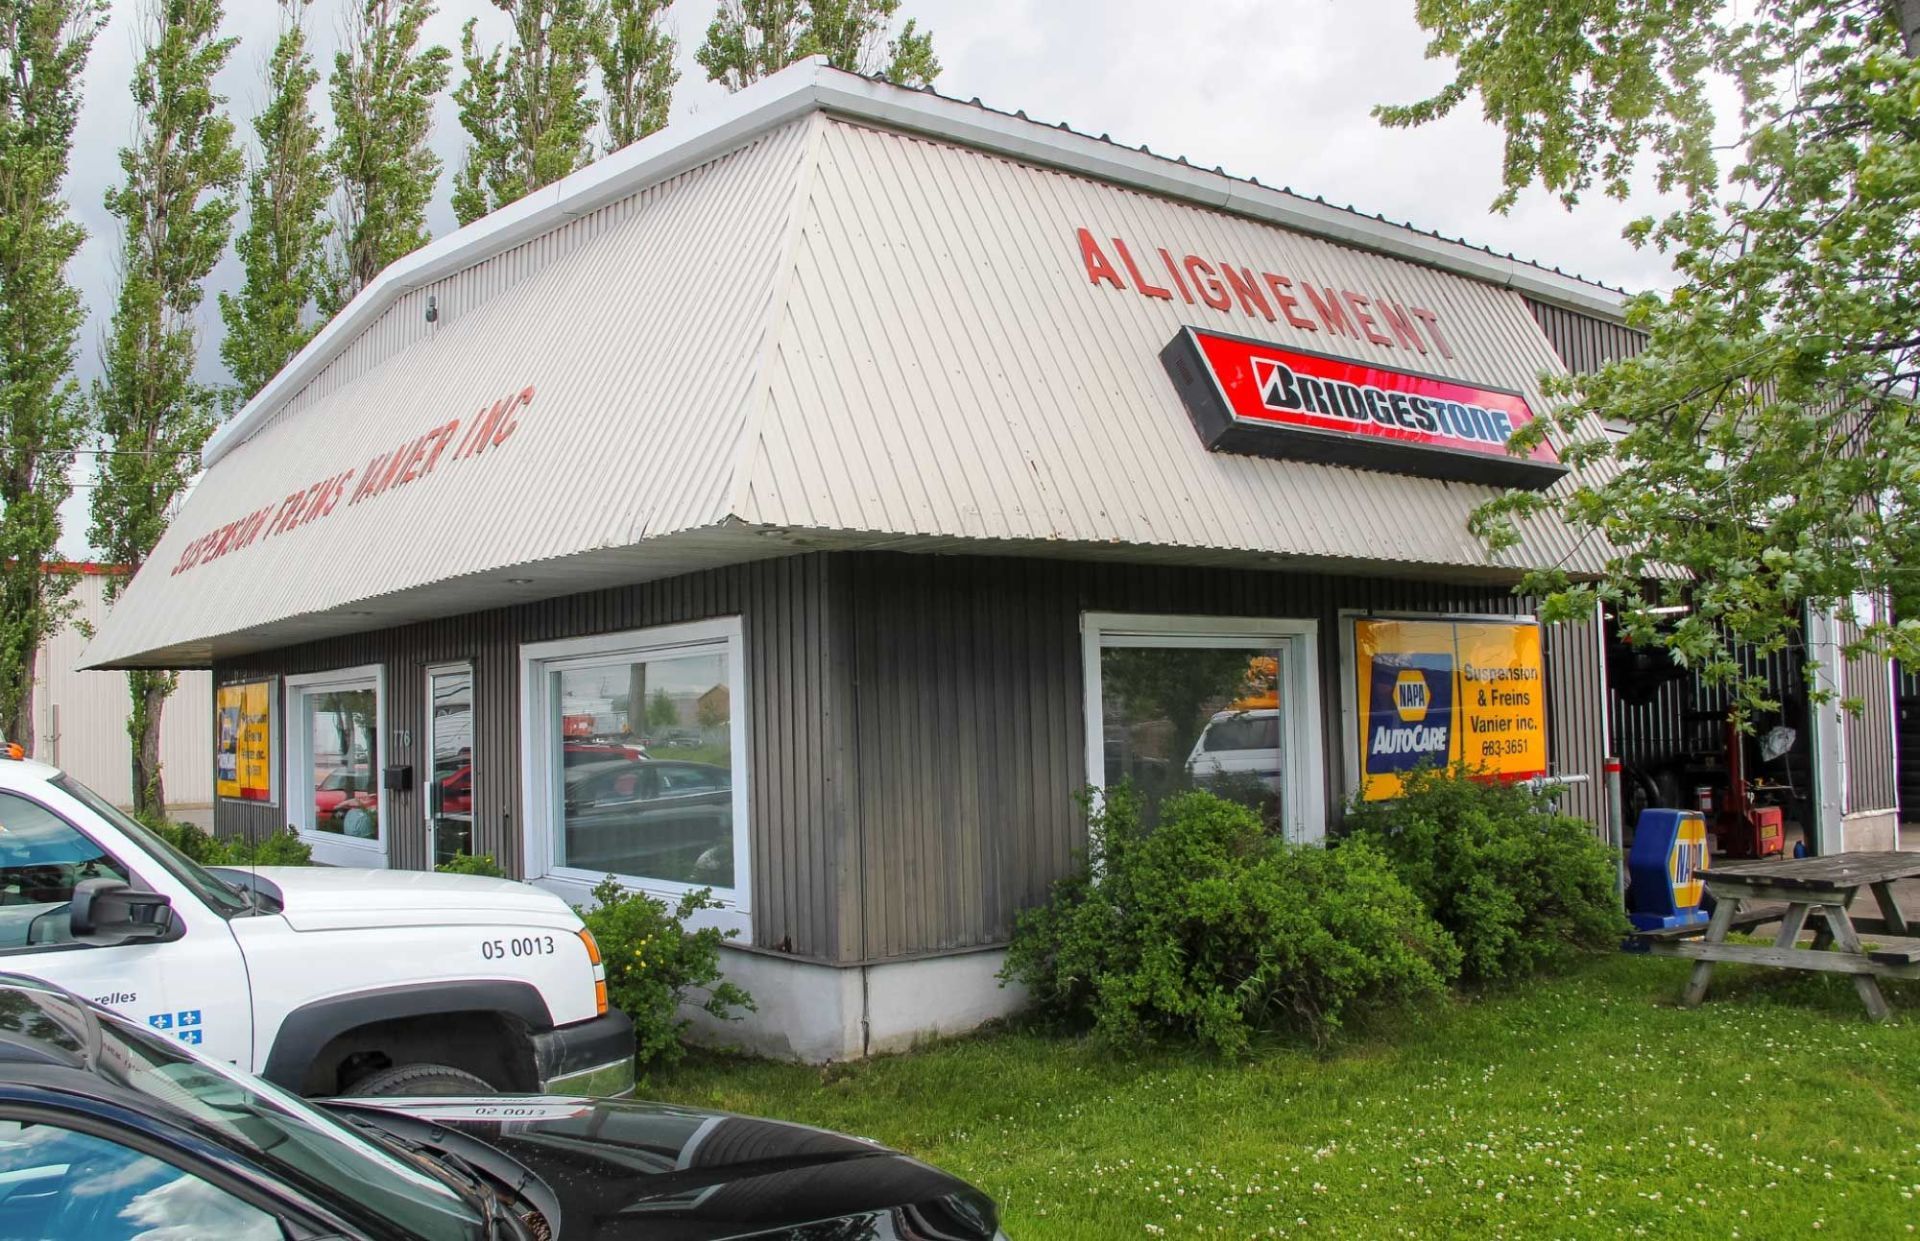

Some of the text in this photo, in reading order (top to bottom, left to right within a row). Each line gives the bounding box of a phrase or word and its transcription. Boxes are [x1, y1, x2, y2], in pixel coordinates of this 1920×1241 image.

[1076, 227, 1454, 360] ALIGNEMENT
[1252, 358, 1513, 443] BRIDGESTONE
[452, 384, 536, 461] INC
[1464, 663, 1538, 685] Suspension
[1399, 684, 1426, 708] NAPA
[1477, 688, 1531, 708] & Freins
[1470, 713, 1538, 733] Vanier inc.
[481, 935, 554, 960] 05 0013
